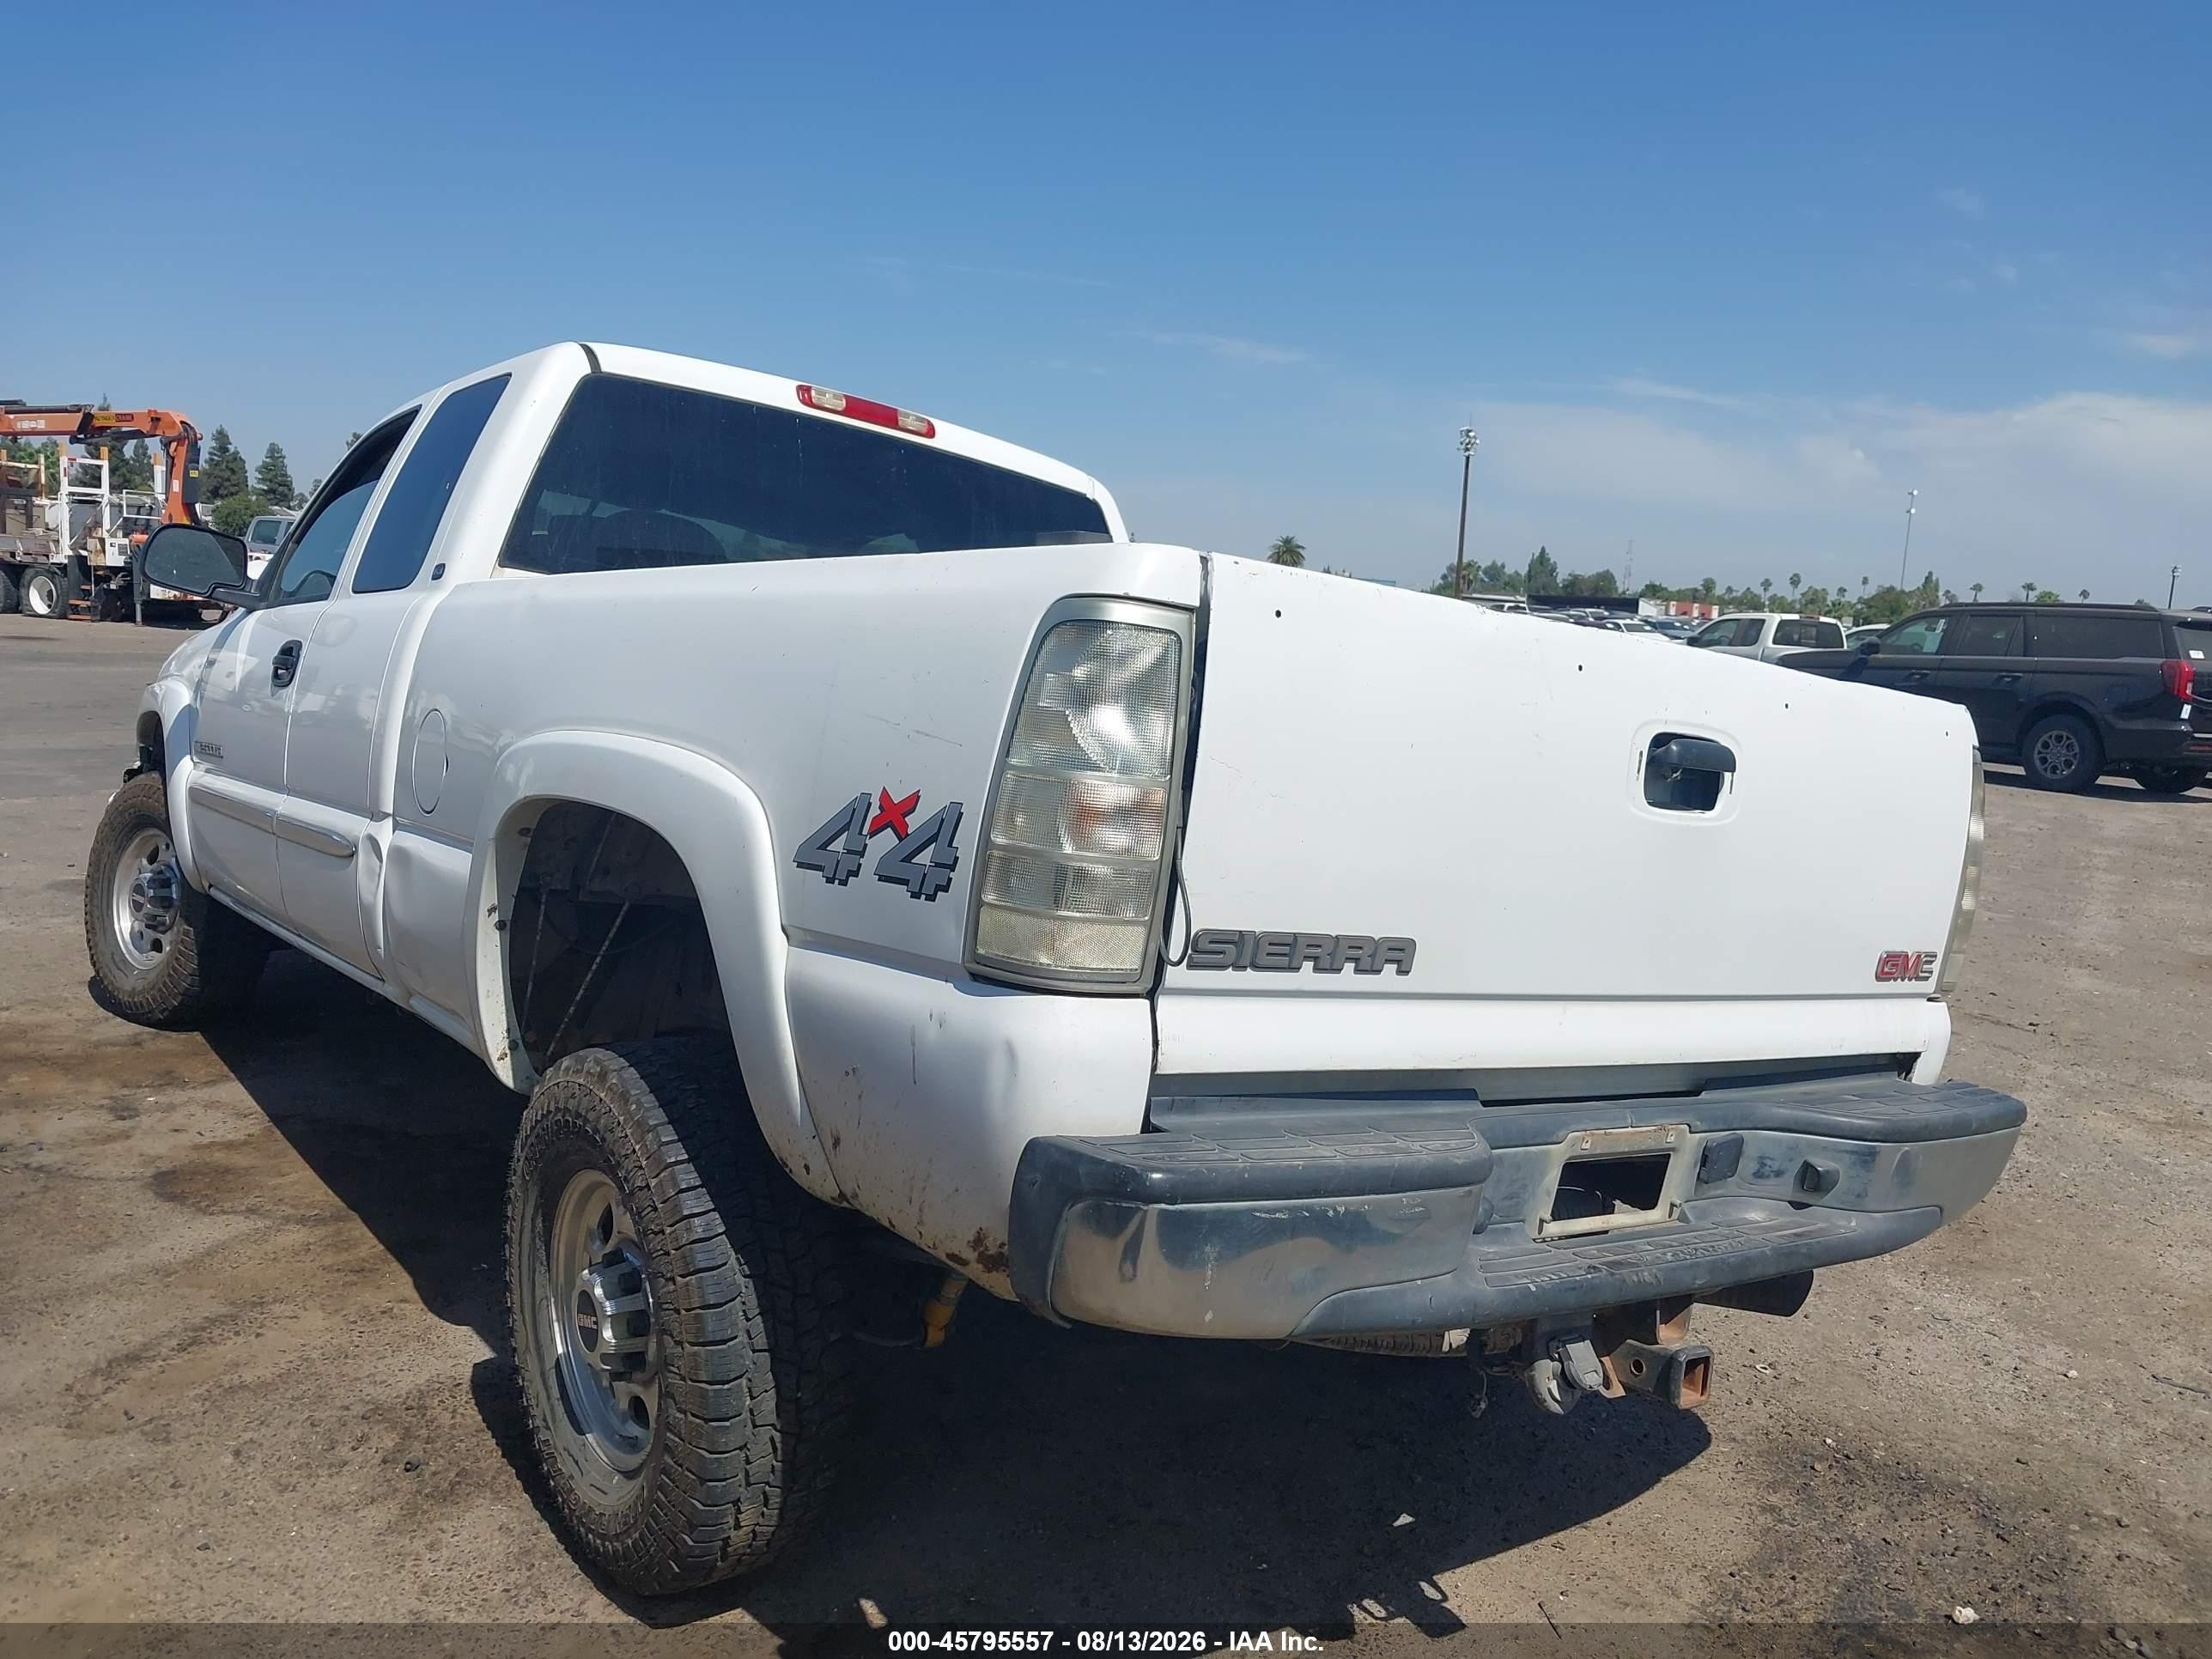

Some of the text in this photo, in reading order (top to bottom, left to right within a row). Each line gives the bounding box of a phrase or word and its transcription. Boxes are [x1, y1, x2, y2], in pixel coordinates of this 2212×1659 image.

[1187, 928, 1416, 975] SIERRA
[1875, 951, 1938, 981] GMC
[578, 1313, 599, 1329] GMC
